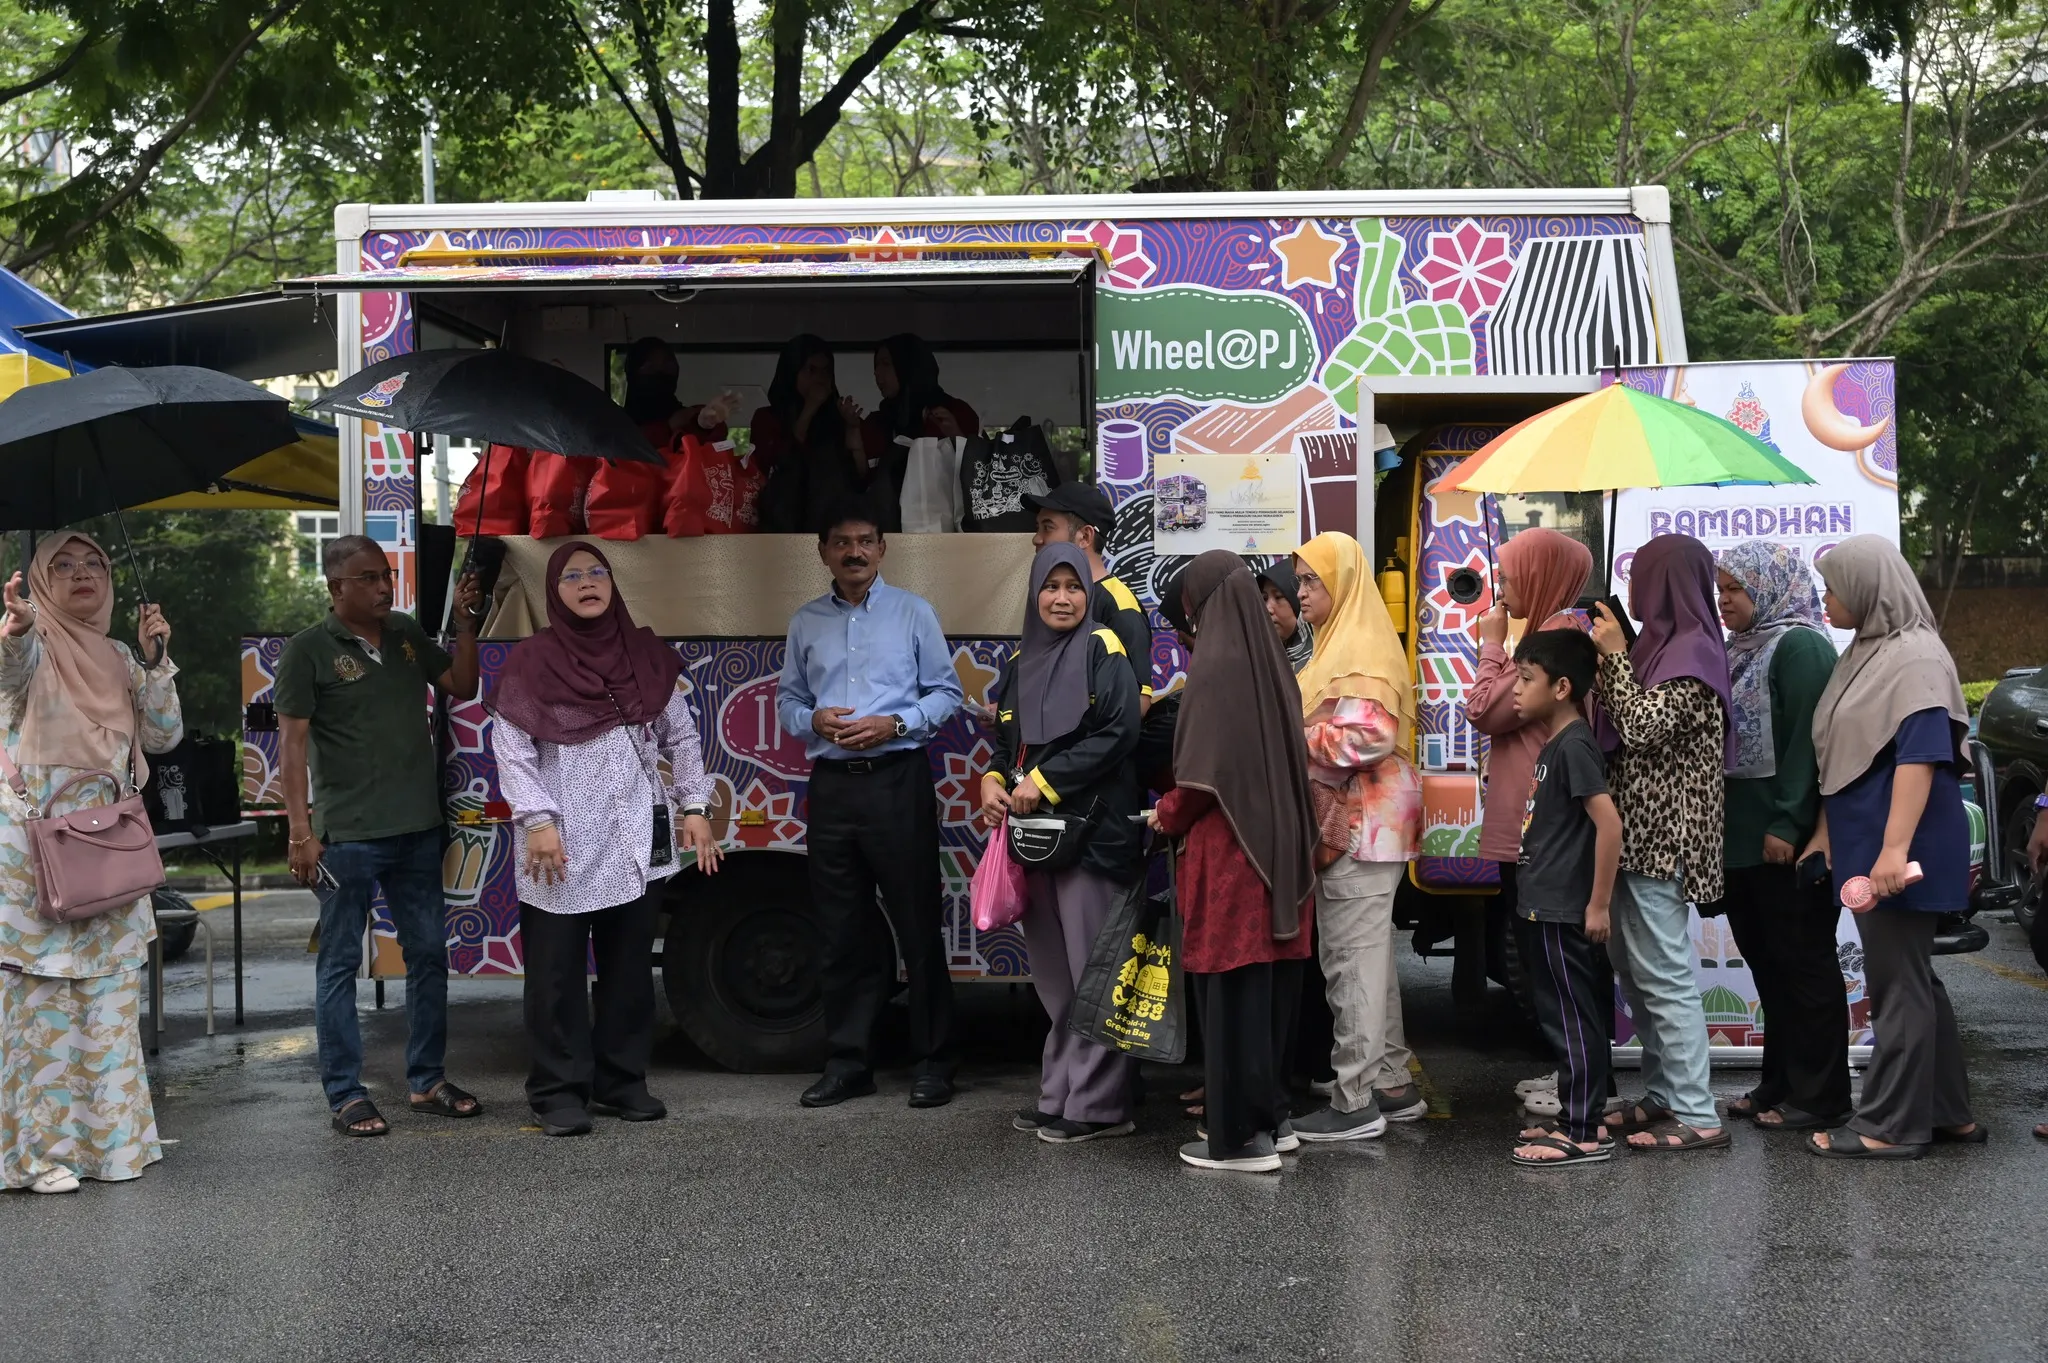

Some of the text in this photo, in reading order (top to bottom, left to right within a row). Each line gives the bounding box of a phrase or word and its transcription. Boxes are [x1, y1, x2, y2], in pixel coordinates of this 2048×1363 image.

[1111, 329, 1297, 370] Wheel@PJ
[1650, 505, 1852, 538] RAMADHAN
[1105, 1018, 1131, 1035] Green
[1131, 1027, 1151, 1041] Bag
